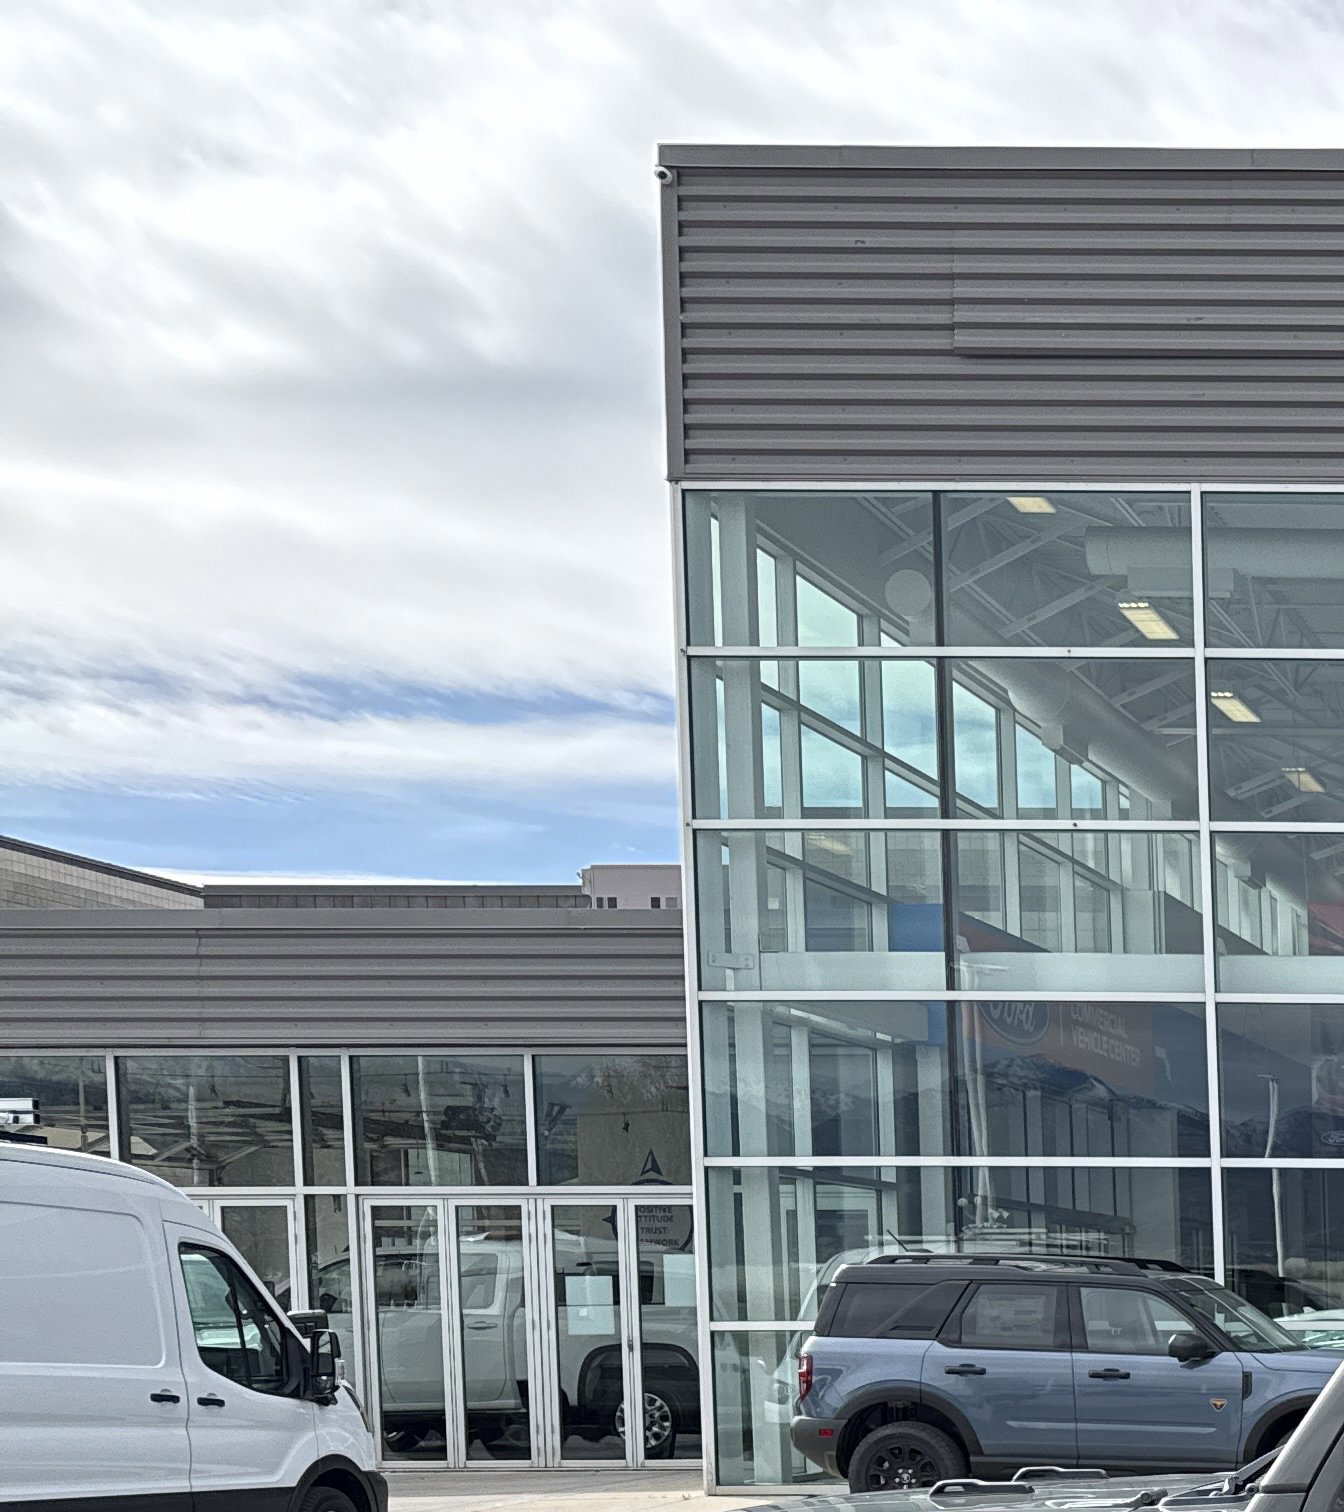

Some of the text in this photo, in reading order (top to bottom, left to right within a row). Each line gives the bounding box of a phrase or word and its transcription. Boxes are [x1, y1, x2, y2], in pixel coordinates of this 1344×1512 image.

[1072, 1023, 1141, 1068] VEHICLE CENTER
[638, 1206, 673, 1214] OSITIVE
[638, 1215, 675, 1223] TTITUDE
[640, 1226, 667, 1235] TRUST
